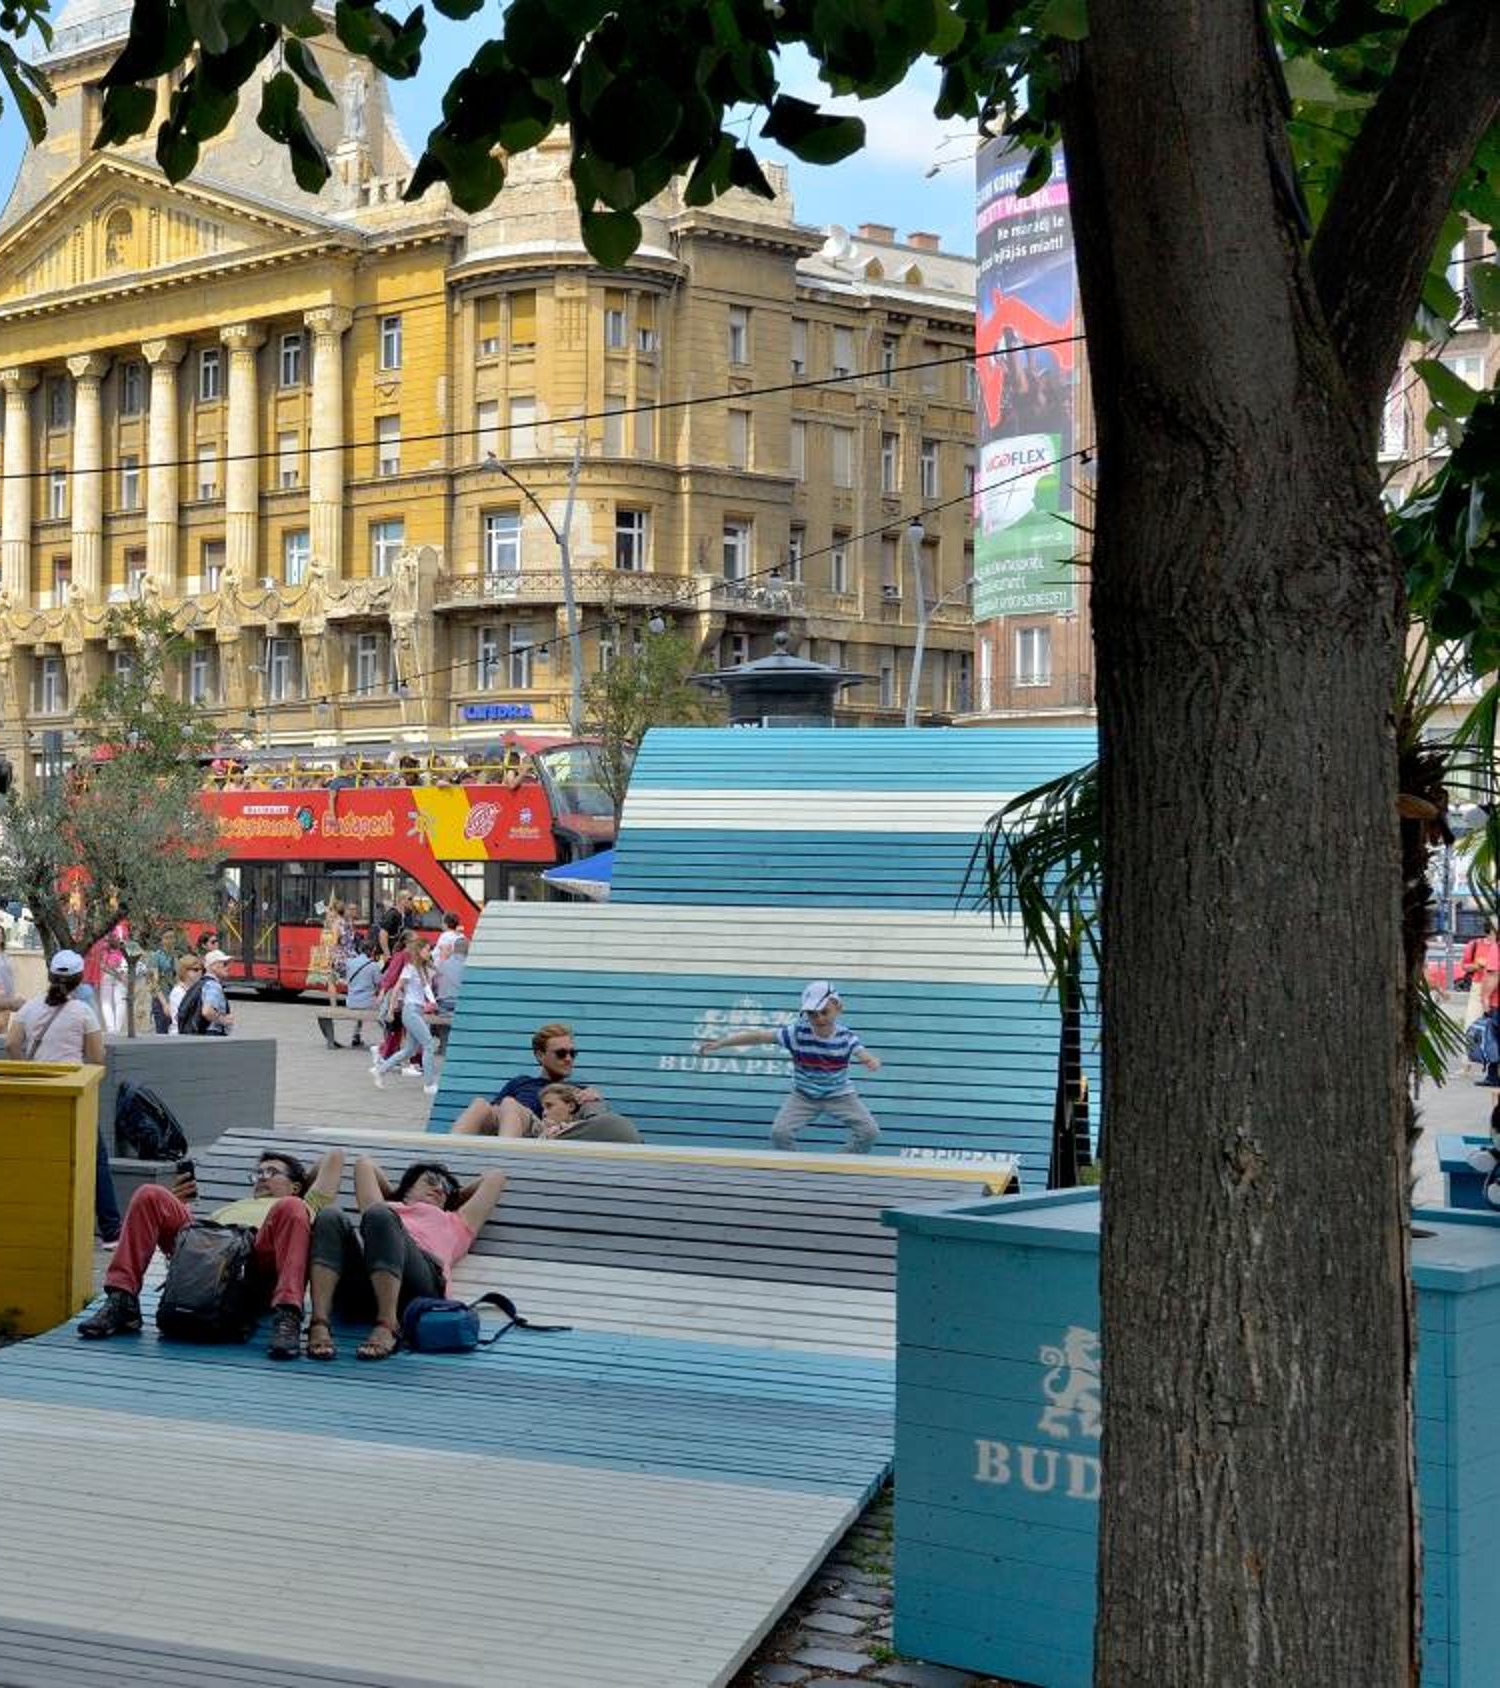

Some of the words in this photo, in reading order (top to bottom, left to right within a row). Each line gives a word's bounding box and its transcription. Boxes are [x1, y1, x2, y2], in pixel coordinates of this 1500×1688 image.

[321, 810, 395, 840] Budapest
[659, 1054, 795, 1075] BUDAPES
[973, 1439, 1102, 1500] BUD
